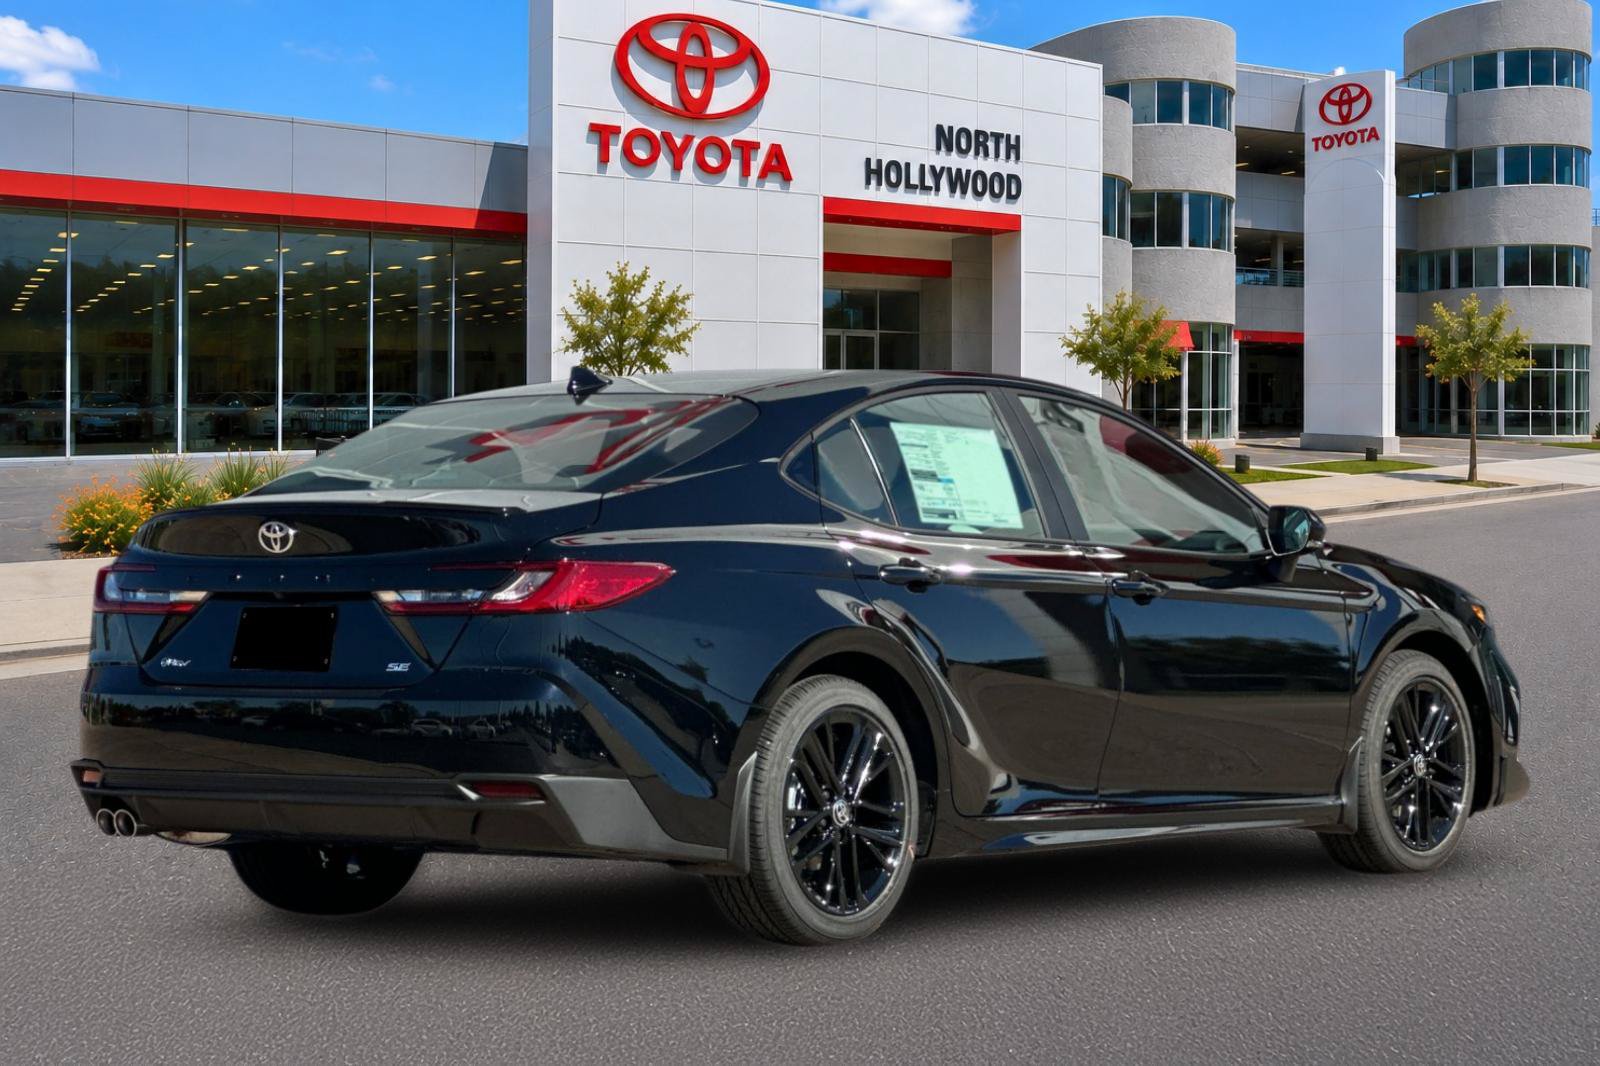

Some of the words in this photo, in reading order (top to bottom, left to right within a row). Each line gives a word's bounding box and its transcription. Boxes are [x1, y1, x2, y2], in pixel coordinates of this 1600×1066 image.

[589, 123, 792, 182] TOYOTA
[935, 124, 1021, 161] NORTH
[1312, 127, 1379, 152] TOYOTA
[865, 157, 1021, 201] HOLLYWOOD
[386, 662, 411, 671] SE
